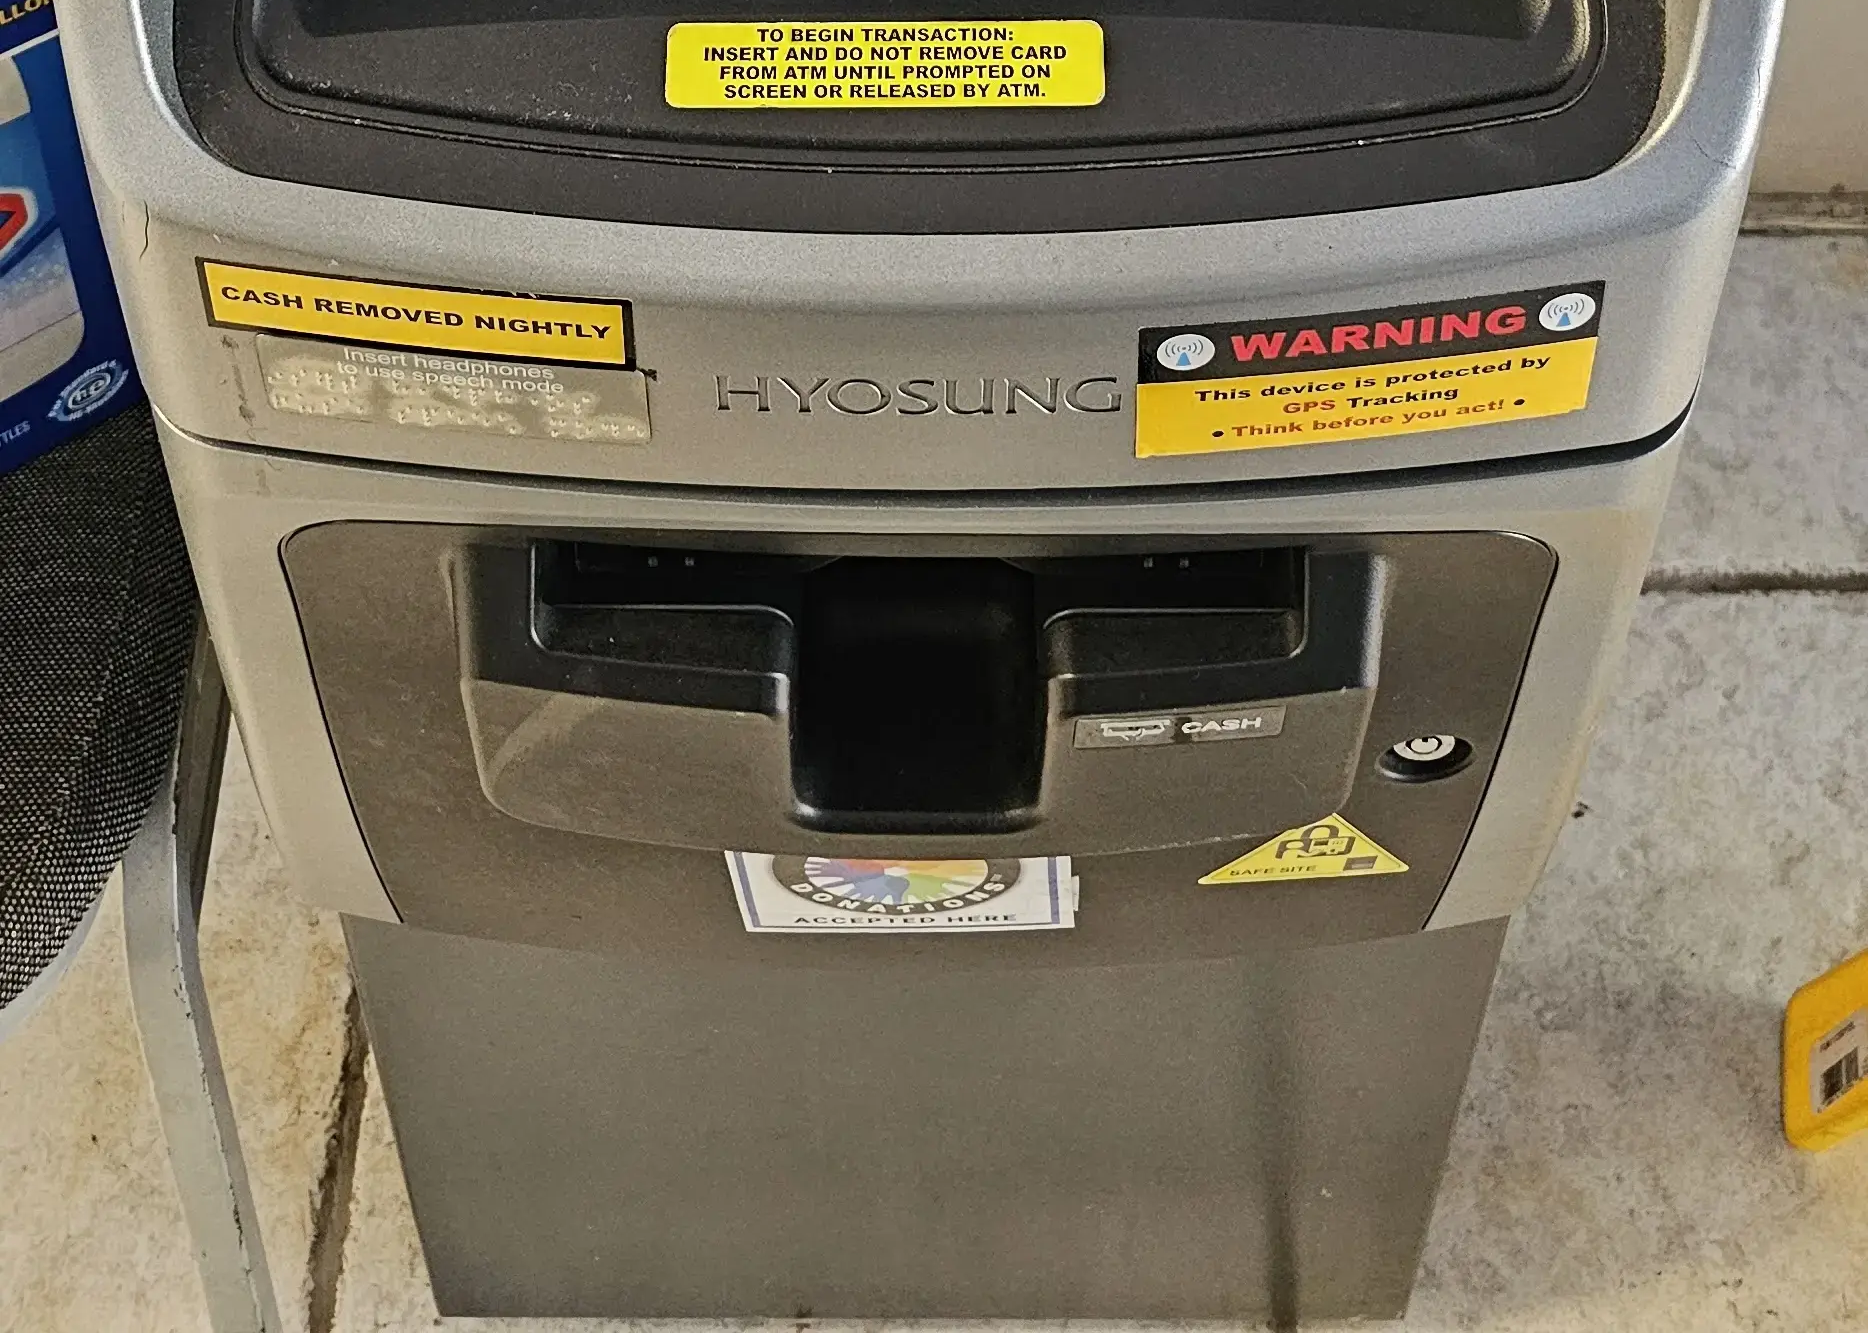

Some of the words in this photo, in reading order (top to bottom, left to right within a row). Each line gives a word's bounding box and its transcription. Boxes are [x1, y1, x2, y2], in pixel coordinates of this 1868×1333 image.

[758, 29, 785, 42] TO
[791, 29, 854, 42] BEGIN
[860, 28, 1014, 41] TRANSACTION:
[704, 47, 779, 61] INSERT
[785, 47, 828, 61] AND
[835, 47, 863, 60] DO
[870, 47, 913, 60] NOT
[919, 46, 1004, 60] REMOVE
[1010, 45, 1067, 59] CARD
[720, 66, 778, 80] FROM
[783, 66, 827, 79] ATM
[834, 65, 895, 79] UNTIL
[902, 64, 1014, 79] PROMPTED
[1021, 64, 1051, 78] ON
[724, 84, 807, 98] SCREEN
[813, 84, 843, 98] OR
[850, 84, 956, 98] RELEASED
[964, 83, 994, 97] BY
[997, 83, 1046, 97] ATM.
[221, 286, 303, 310] CASH
[314, 298, 464, 327] REMOVED
[474, 315, 611, 340] NIGHTLY
[1230, 305, 1527, 362] WARNING
[337, 361, 360, 375] to
[365, 365, 405, 380] use
[412, 369, 495, 393] speech
[502, 378, 563, 394] mode
[344, 348, 408, 367] Insert
[414, 355, 555, 382] headphones
[1195, 387, 1251, 403] This
[1261, 379, 1346, 397] device
[1356, 376, 1377, 389] is
[1385, 359, 1512, 389] protected
[1520, 355, 1551, 372] by
[714, 375, 1122, 415] HYOSUNG
[1283, 399, 1336, 415] GPS
[1346, 386, 1460, 410] Tracking
[1232, 421, 1304, 437] Think
[1312, 413, 1394, 433] before
[1401, 408, 1449, 426] you
[1456, 399, 1505, 416] act!
[1181, 717, 1262, 735] CASH
[1230, 867, 1274, 875] SAFE
[1280, 865, 1318, 873] SITE
[791, 882, 1005, 913] DONATIONS
[948, 914, 1017, 922] HERE
